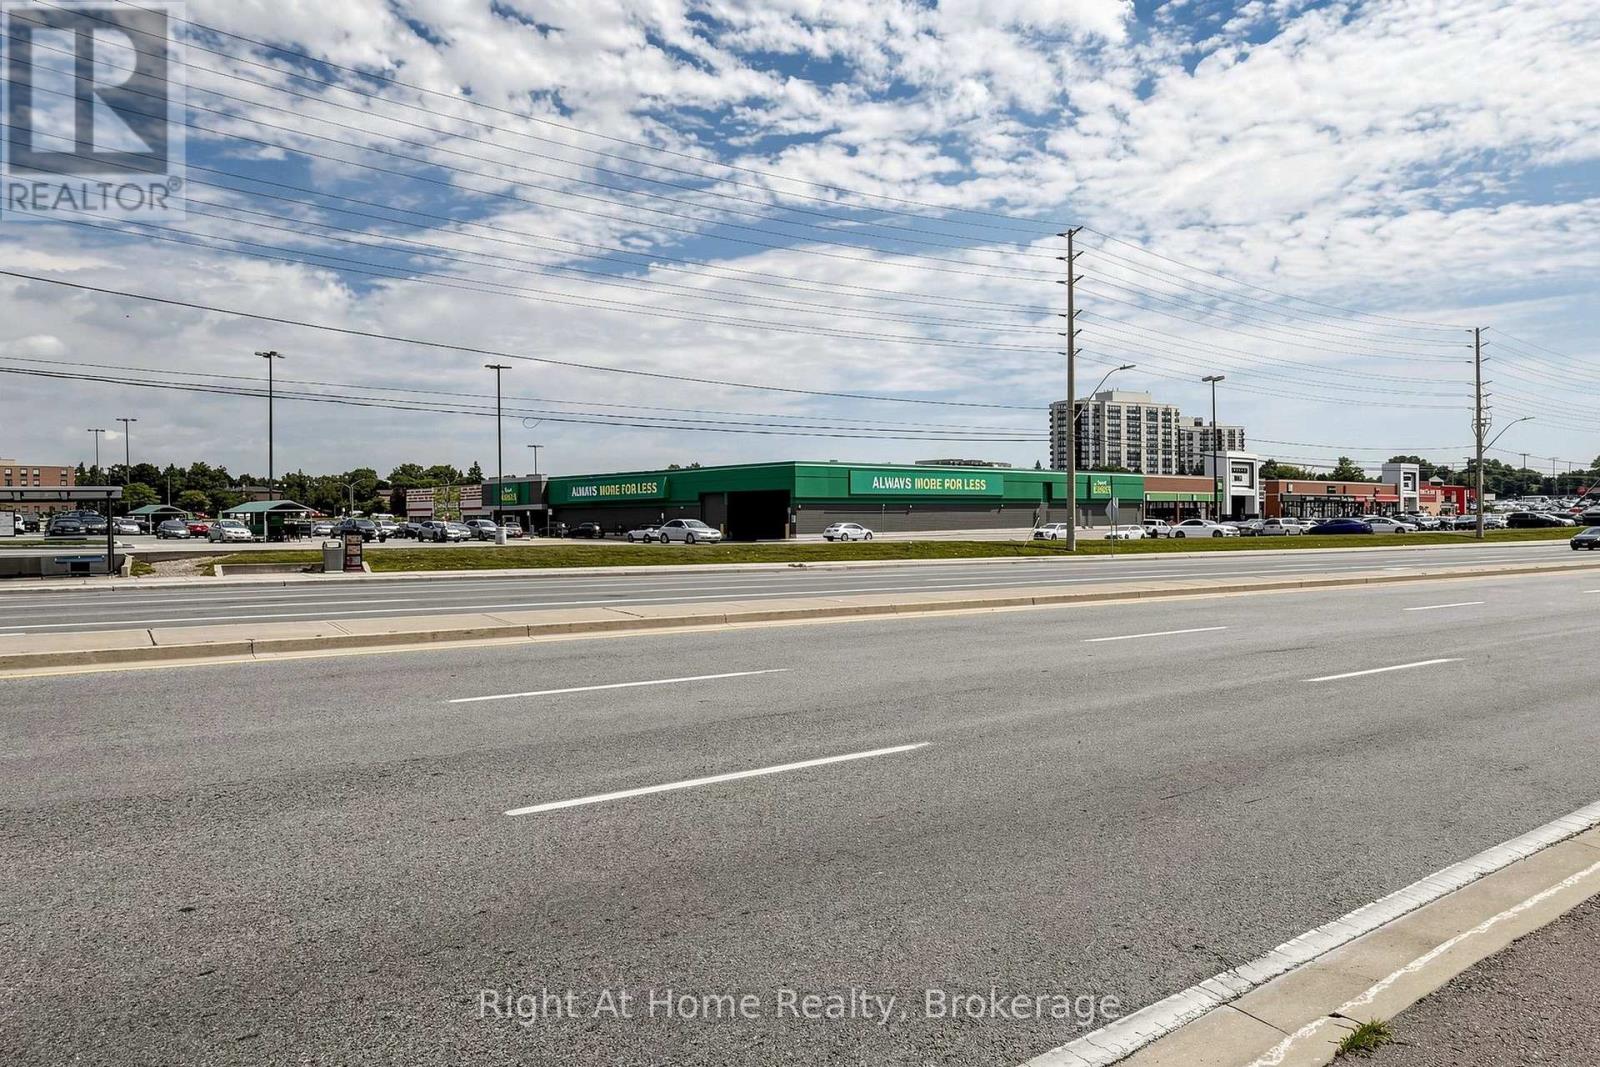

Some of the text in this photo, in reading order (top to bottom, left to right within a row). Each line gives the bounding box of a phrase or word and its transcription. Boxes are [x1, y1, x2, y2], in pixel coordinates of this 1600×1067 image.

[621, 483, 637, 495] FOR
[637, 482, 658, 494] LESS
[872, 476, 986, 491] ALWAYS MORE FOR LESS
